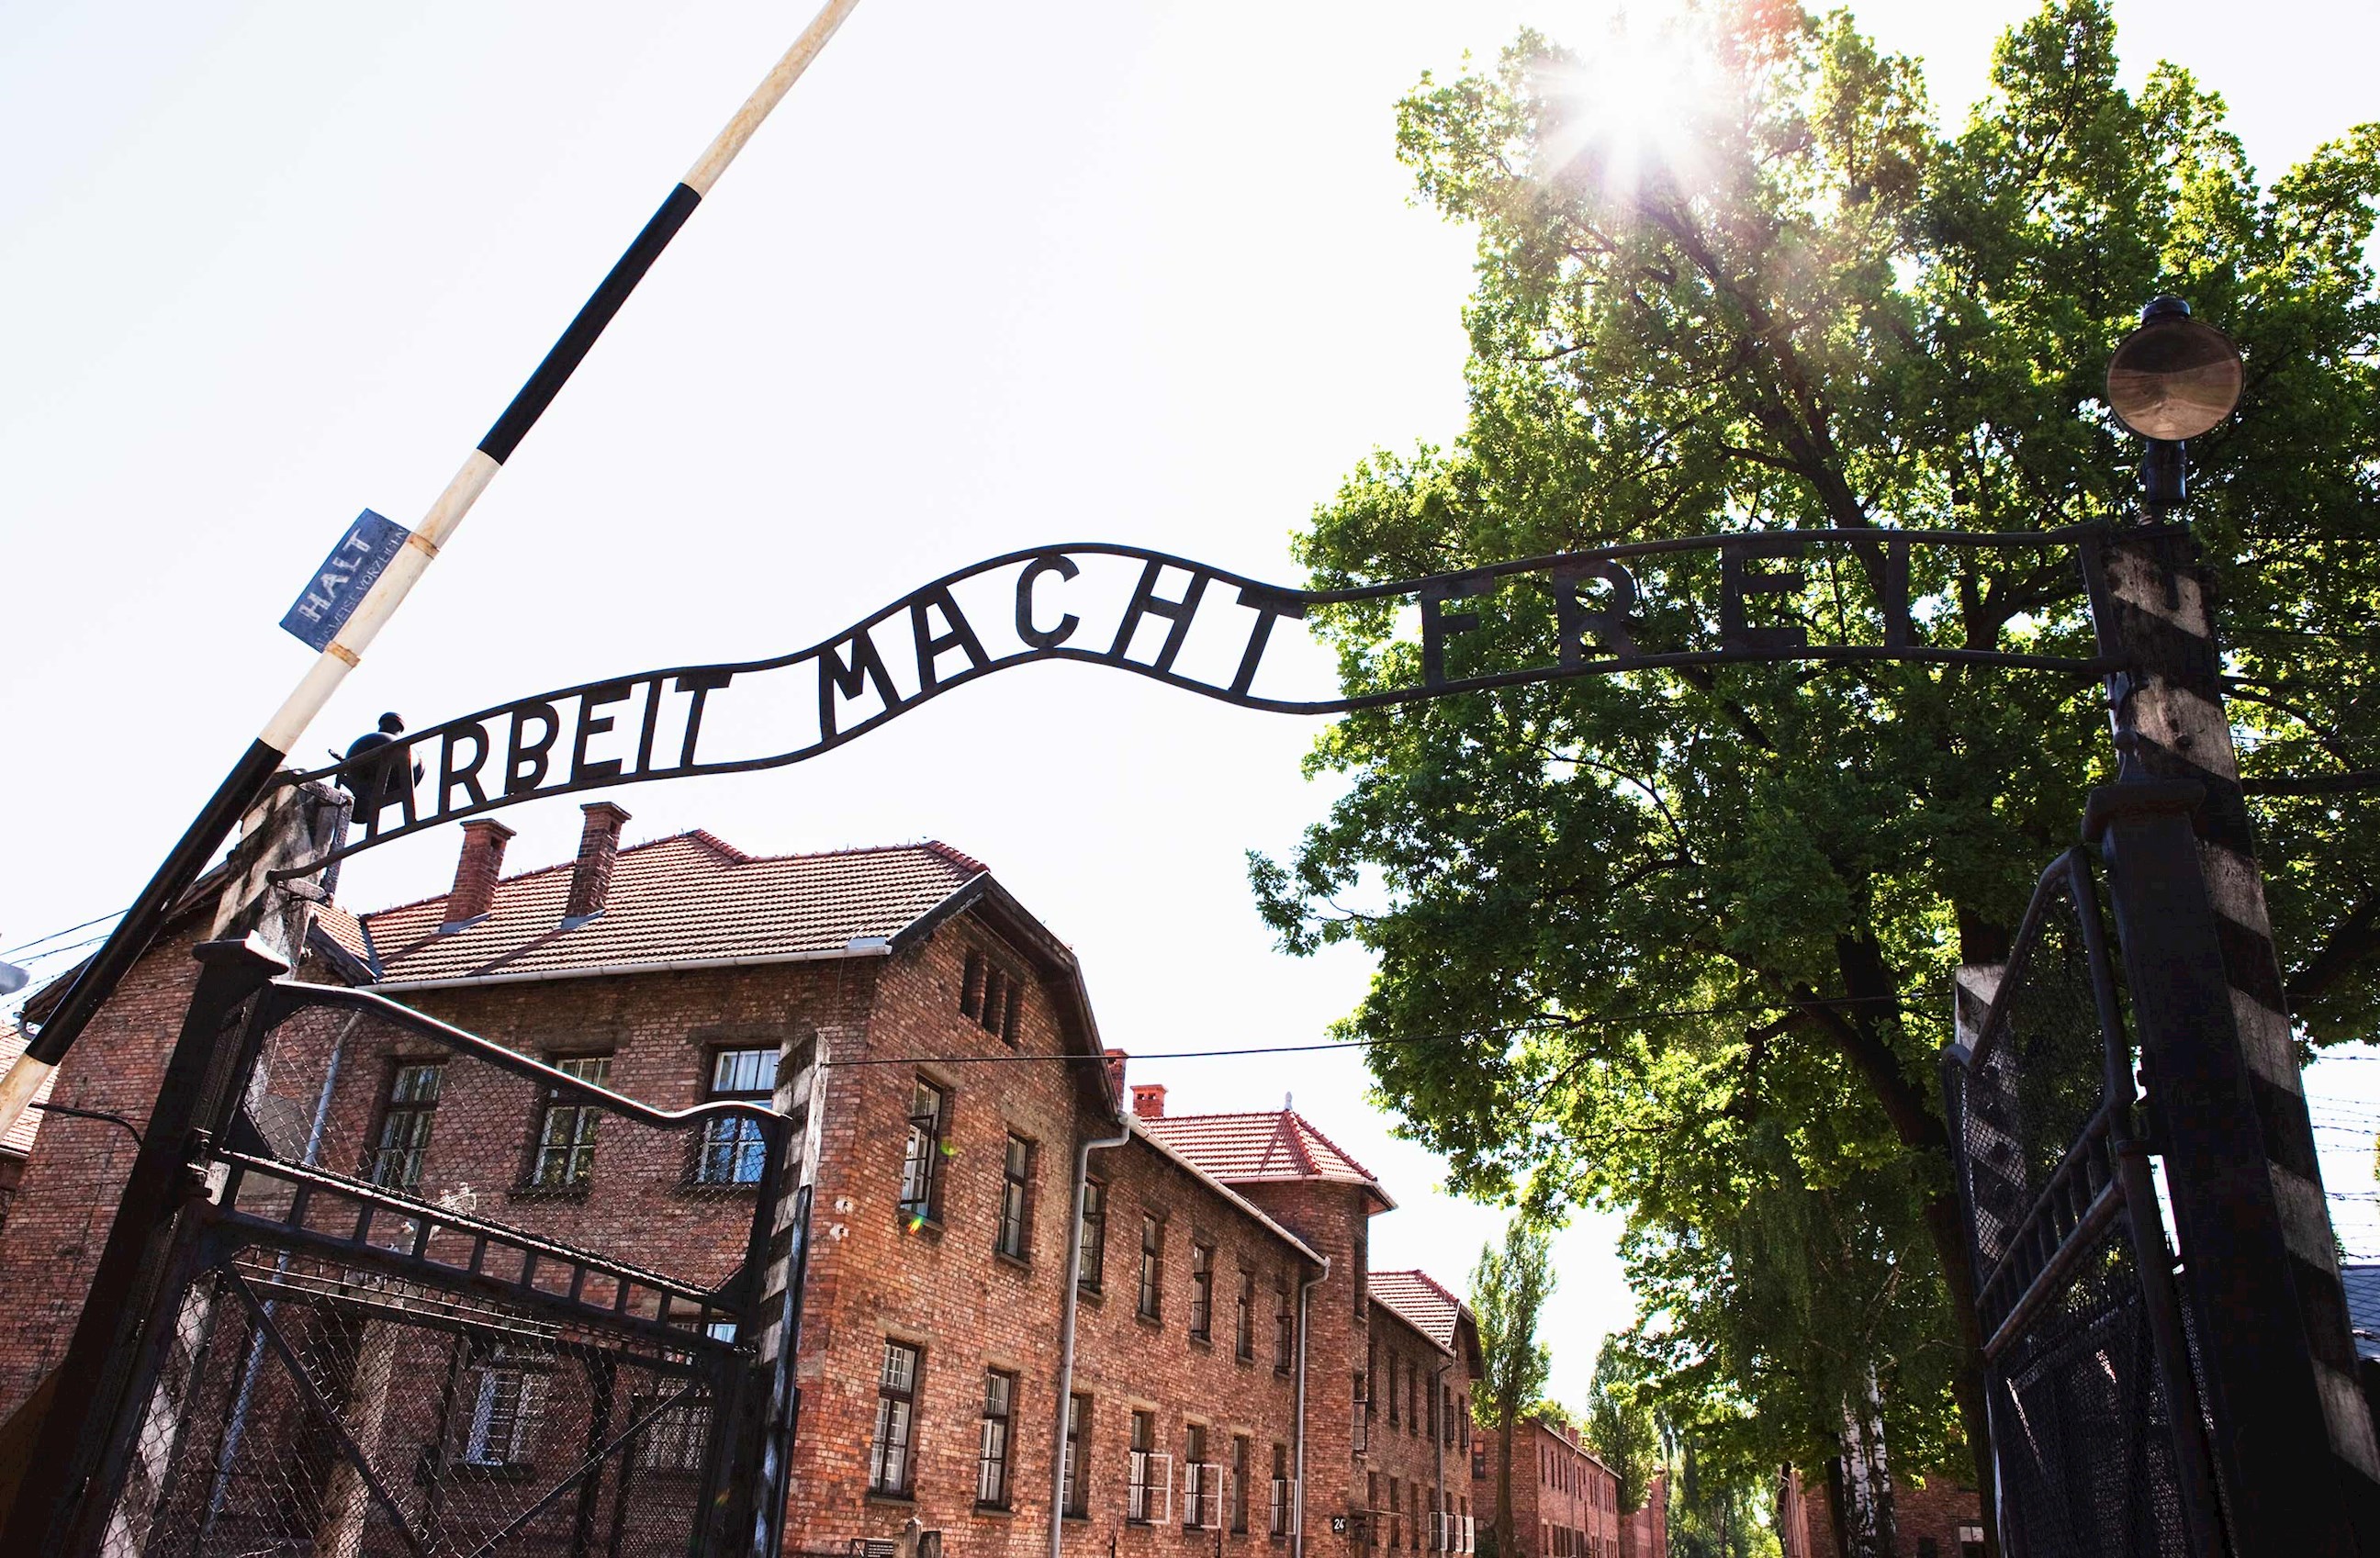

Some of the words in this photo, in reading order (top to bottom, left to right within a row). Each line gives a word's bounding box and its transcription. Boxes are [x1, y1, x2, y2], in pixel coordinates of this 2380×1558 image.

[298, 527, 371, 623] HALT
[365, 668, 734, 842] ARBEIT
[817, 549, 1308, 745] MACHT
[1420, 534, 1910, 690] FREI
